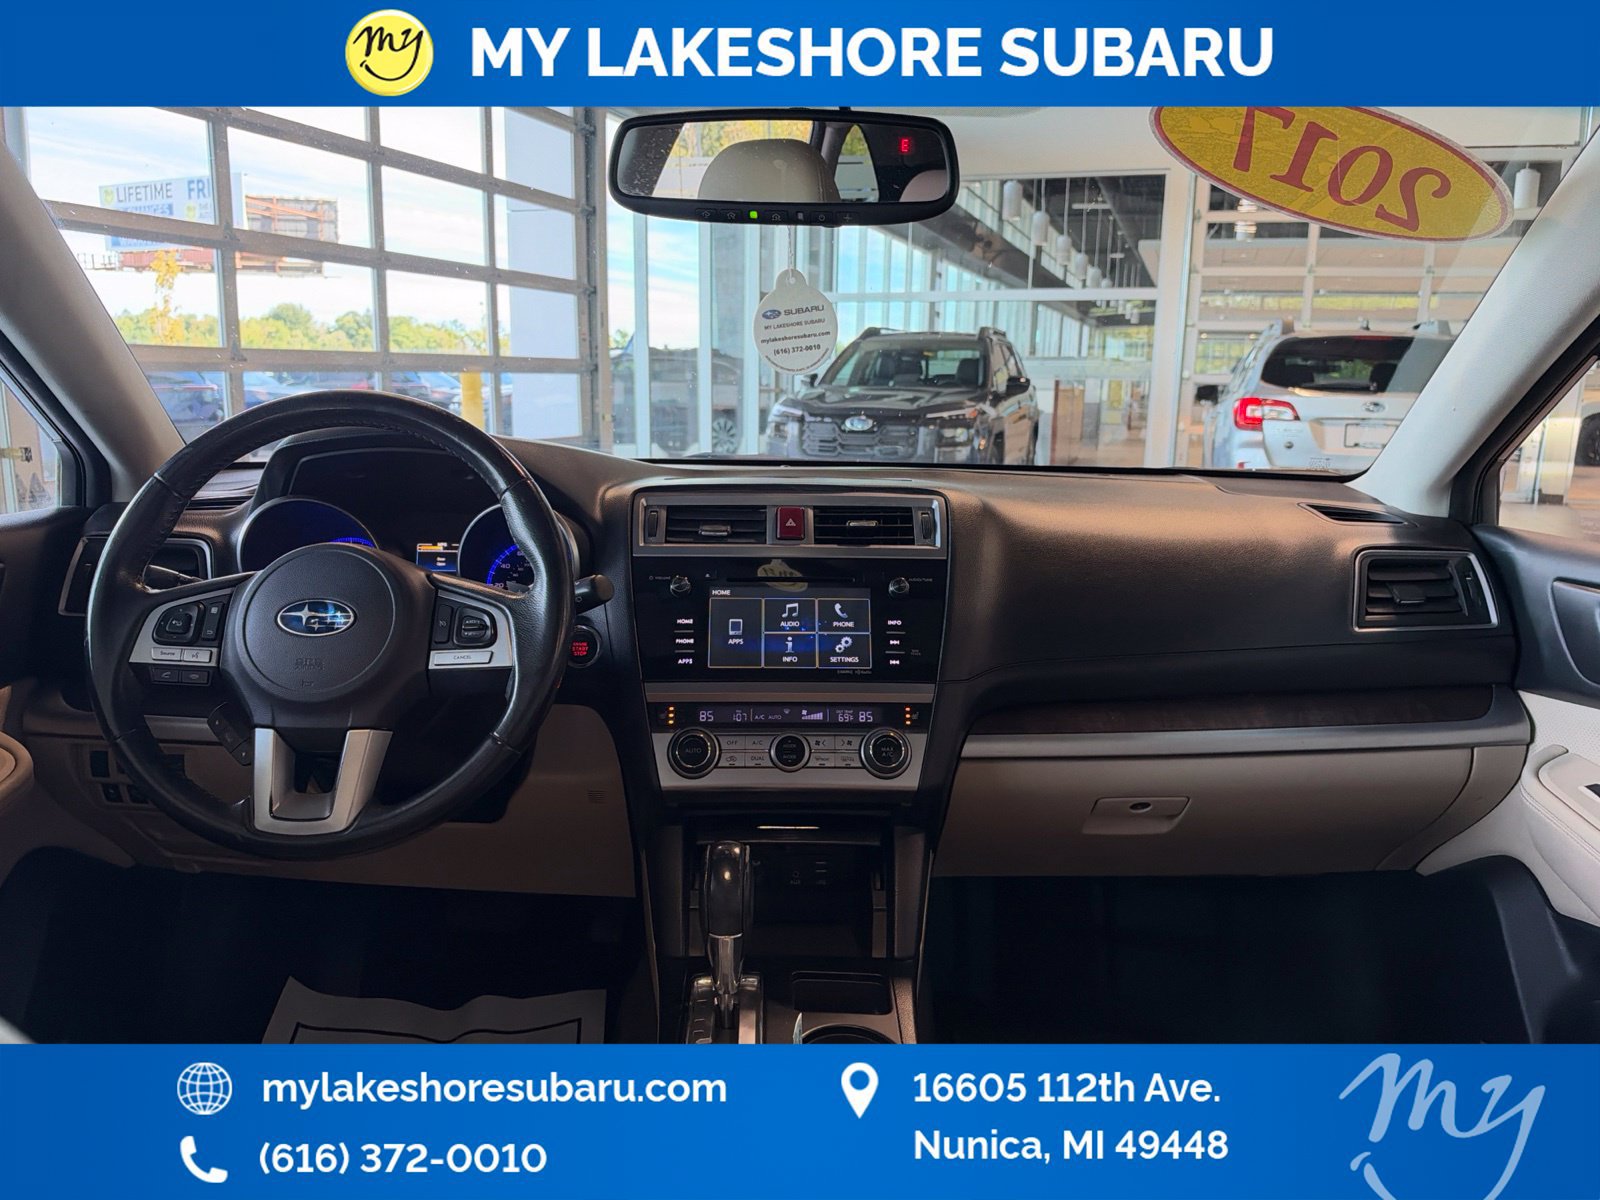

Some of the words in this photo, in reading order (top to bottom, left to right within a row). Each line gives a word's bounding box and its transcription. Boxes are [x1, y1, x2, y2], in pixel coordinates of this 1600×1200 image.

[115, 182, 173, 203] LIFETIME
[783, 304, 825, 316] SUBARU
[773, 321, 803, 330] LAKESHORE
[804, 318, 826, 326] SUBARU
[760, 331, 831, 344] mylakeshoresubaru.com
[773, 347, 791, 356] (616)
[791, 344, 821, 354] 372-0010
[699, 710, 714, 722] 85
[858, 711, 873, 722] 85
